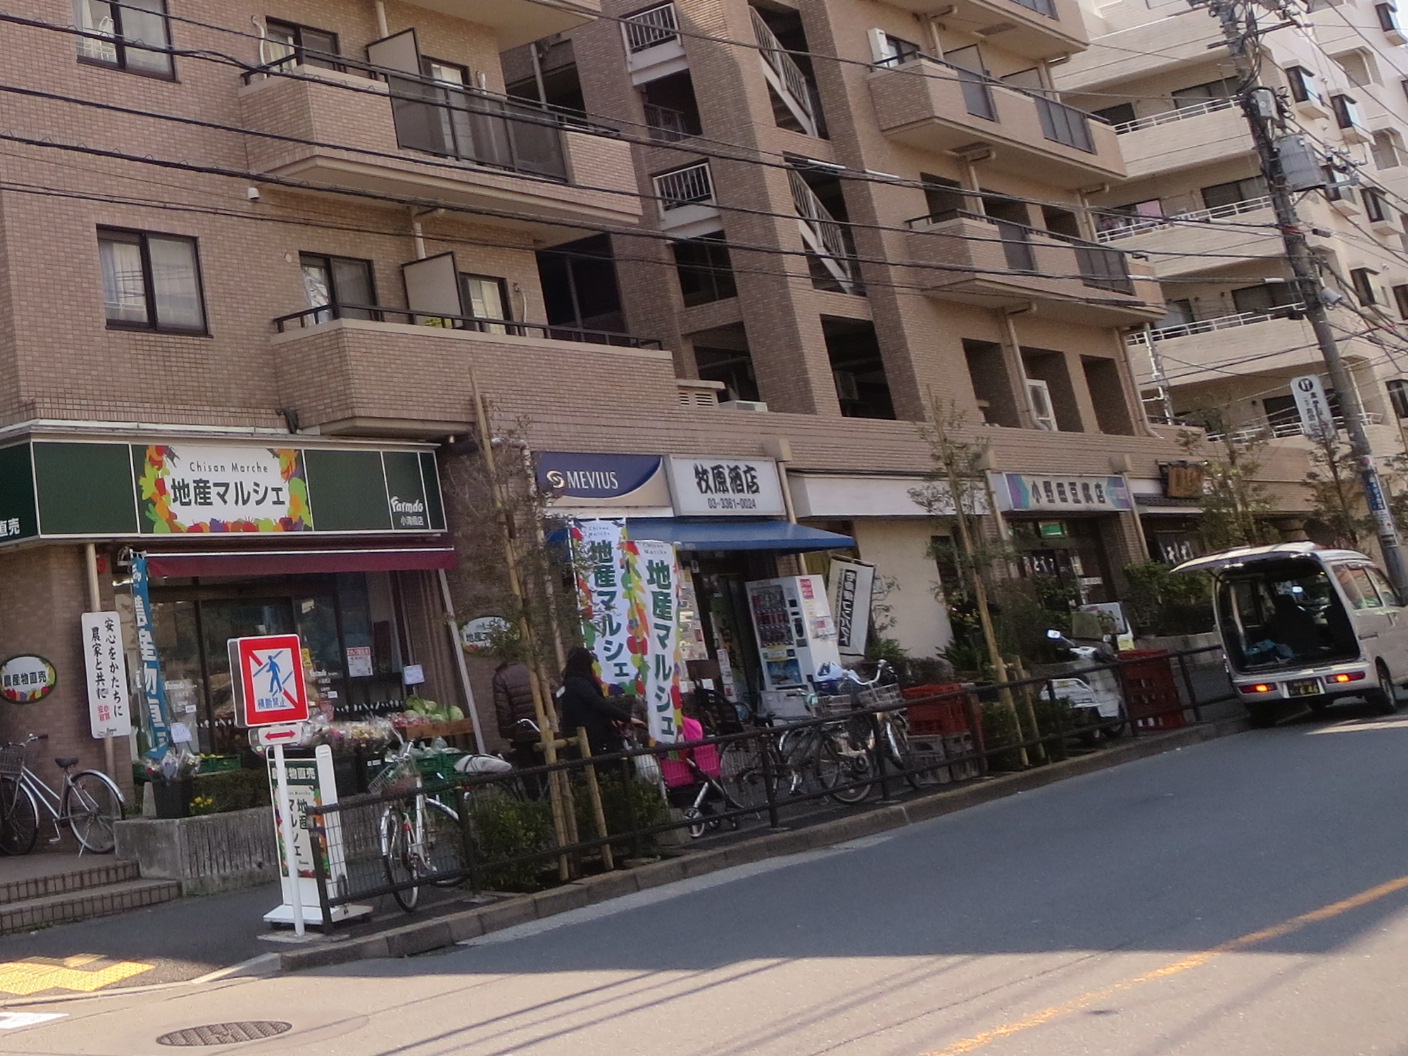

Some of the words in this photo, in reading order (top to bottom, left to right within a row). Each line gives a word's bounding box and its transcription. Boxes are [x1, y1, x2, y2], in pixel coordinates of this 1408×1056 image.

[189, 461, 226, 473] Chisan
[231, 462, 268, 473] Marche
[566, 471, 619, 490] MEVIUS
[694, 463, 760, 495] 牧原酒店
[171, 478, 286, 506] 地産マルシェ
[390, 495, 424, 513] Farmdo
[591, 539, 630, 678] 地産マルシェ
[646, 559, 675, 736] 地産マルシェ
[91, 626, 106, 700] 農家と共に
[105, 617, 123, 718] 安心をかたちに
[3, 670, 47, 688] 農産物直売
[257, 696, 287, 710] 横断禁止
